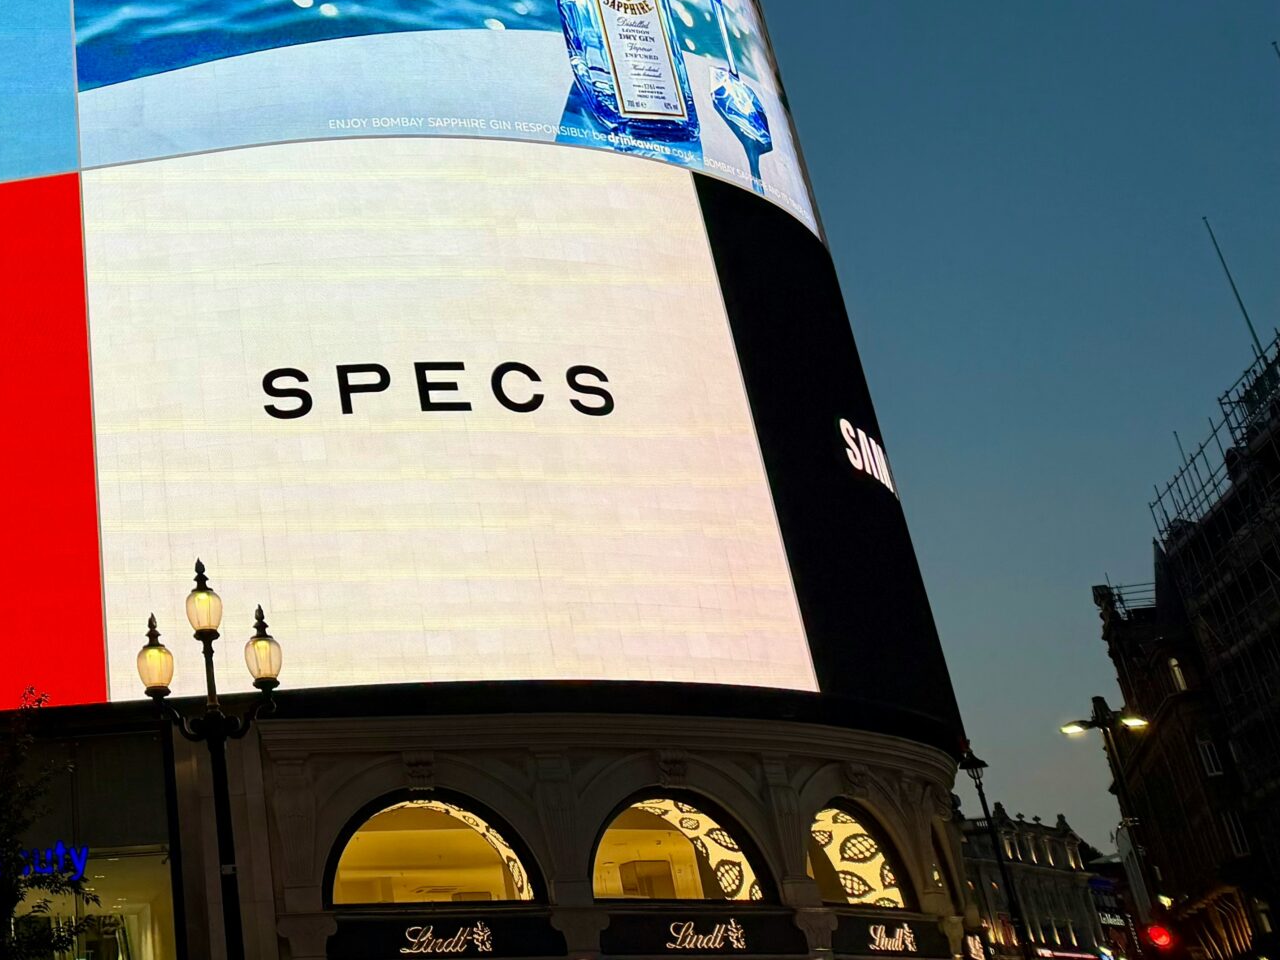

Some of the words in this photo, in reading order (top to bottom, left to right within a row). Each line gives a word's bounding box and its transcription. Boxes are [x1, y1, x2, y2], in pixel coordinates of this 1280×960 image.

[329, 118, 368, 129] ENJOY
[372, 117, 424, 127] BOMBAY
[428, 117, 486, 129] SAPPHIRE
[489, 119, 511, 130] GIN
[263, 362, 615, 419] SPECS
[839, 418, 899, 501] SAM
[400, 925, 472, 954] Lindt
[666, 921, 728, 950] Lindt
[869, 924, 904, 951] Lindt
